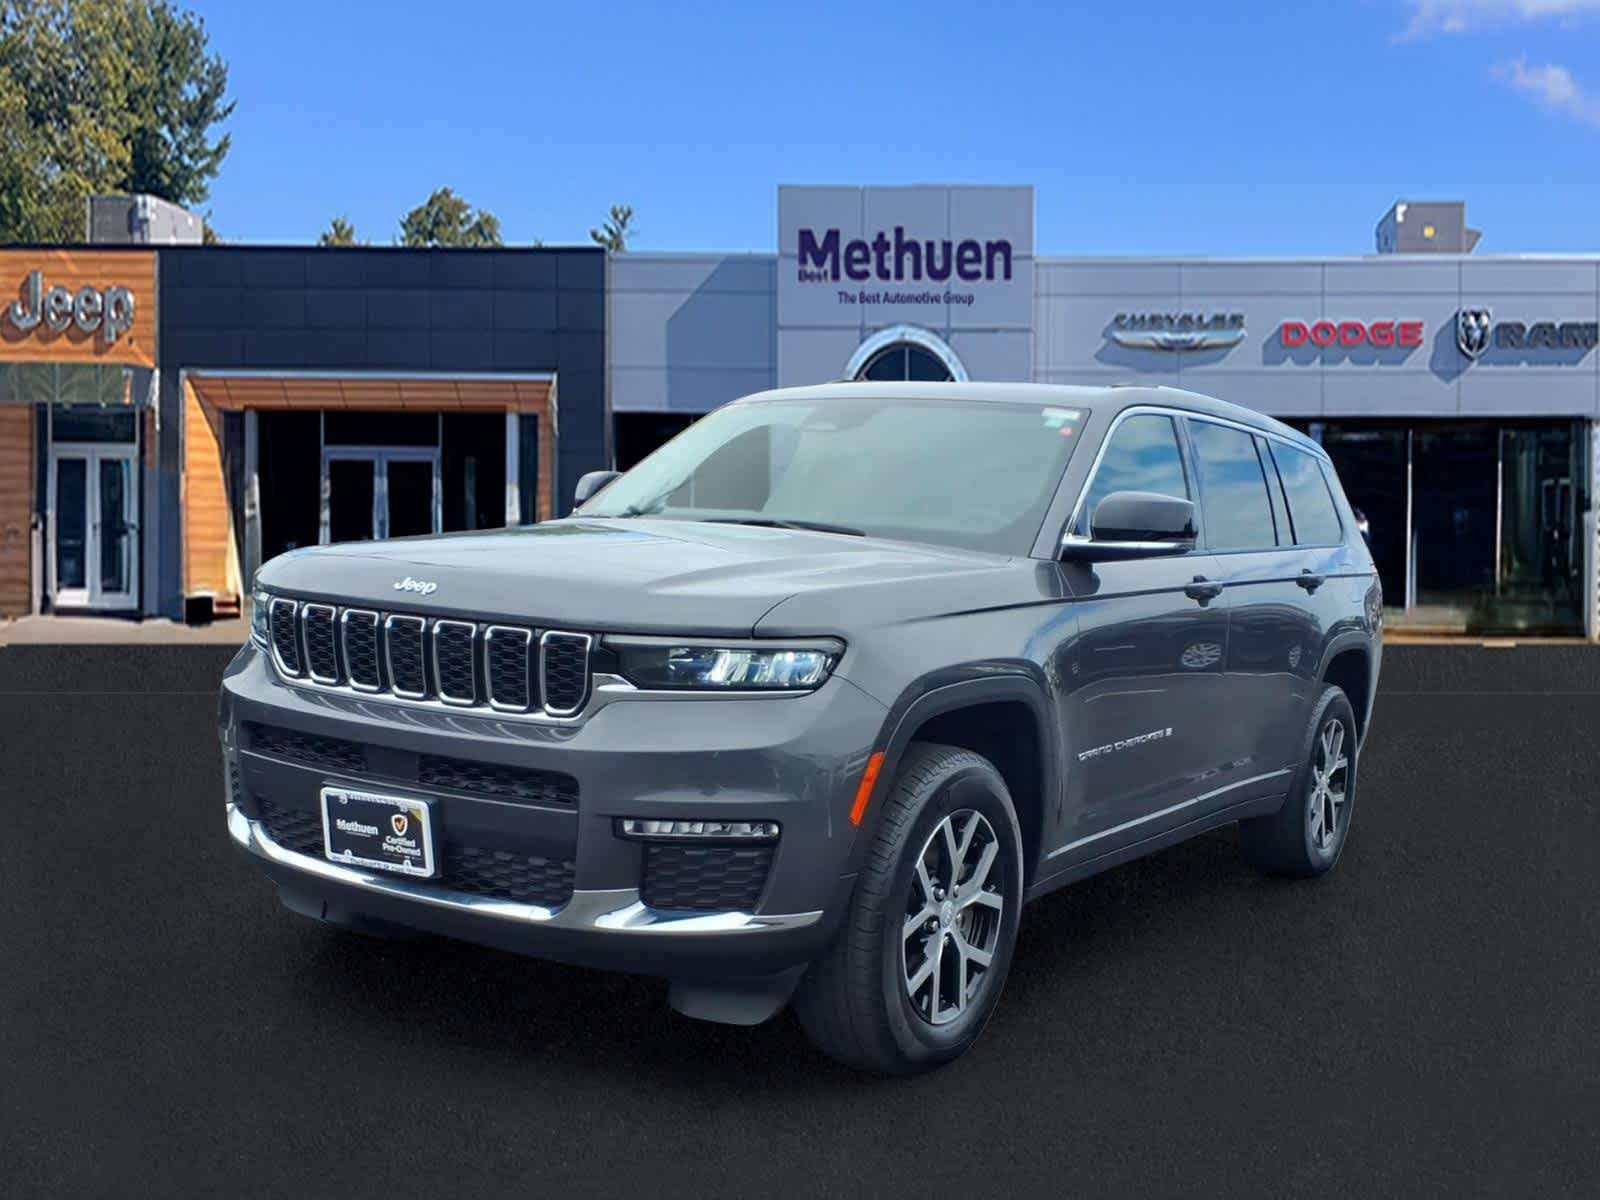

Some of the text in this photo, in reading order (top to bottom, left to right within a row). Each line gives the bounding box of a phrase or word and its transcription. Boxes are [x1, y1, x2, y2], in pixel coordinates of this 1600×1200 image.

[798, 226, 1012, 281] Methuen
[798, 269, 828, 283] Best
[9, 271, 135, 342] Jeep
[838, 291, 974, 306] The Best Automotive Group
[1114, 313, 1245, 330] CHRYSLER
[1280, 321, 1423, 346] DODGE
[1495, 322, 1599, 349] RAM
[393, 576, 437, 595] Jeep
[336, 819, 378, 835] Methuen
[382, 842, 421, 856] Pre-Owned
[385, 835, 416, 848] Certified
